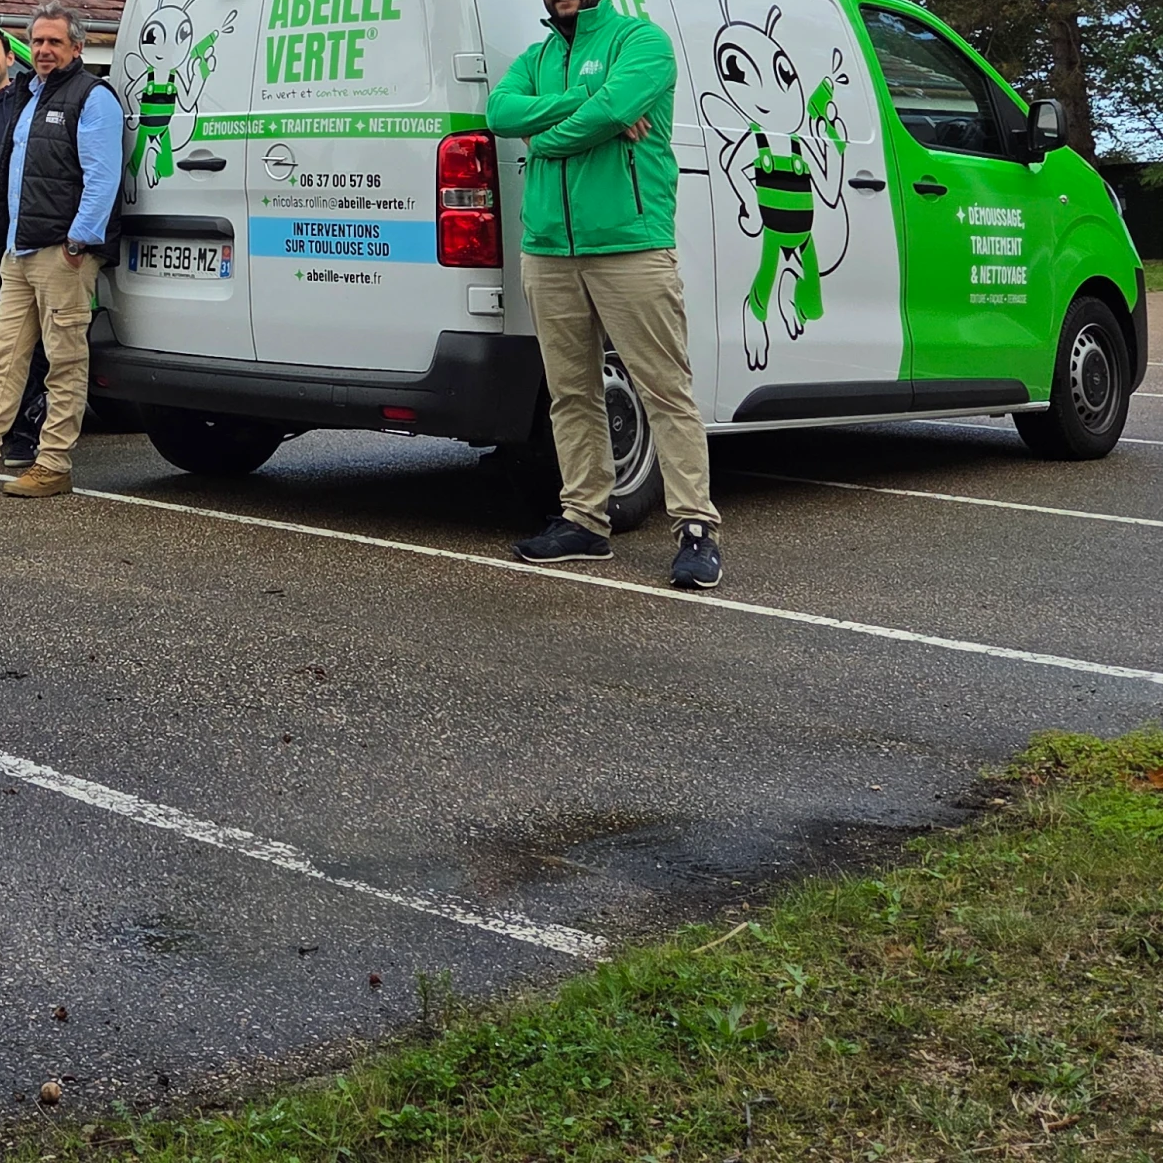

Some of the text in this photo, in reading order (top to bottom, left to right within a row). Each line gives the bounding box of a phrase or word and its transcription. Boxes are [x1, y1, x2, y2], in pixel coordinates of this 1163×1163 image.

[262, 89, 272, 100] En
[276, 89, 296, 99] vert
[300, 88, 312, 98] et
[316, 87, 349, 98] contre
[353, 86, 389, 96] mousse
[202, 117, 442, 136] DÉMOUSSAGE TRAITEMENT NETTOYAGE
[300, 174, 381, 187] 06 37 00 57 96
[272, 196, 416, 210] nicolas.rollin@abeille-verte.fr
[293, 222, 380, 239] INTERVENTIONS
[285, 239, 389, 256] SUR TOULOUSE SUD
[970, 236, 1022, 256] TRAITEMENT
[221, 261, 230, 273] 31
[970, 265, 1027, 284] & NETTOYAGE
[307, 269, 382, 285] abeille-verte.fr
